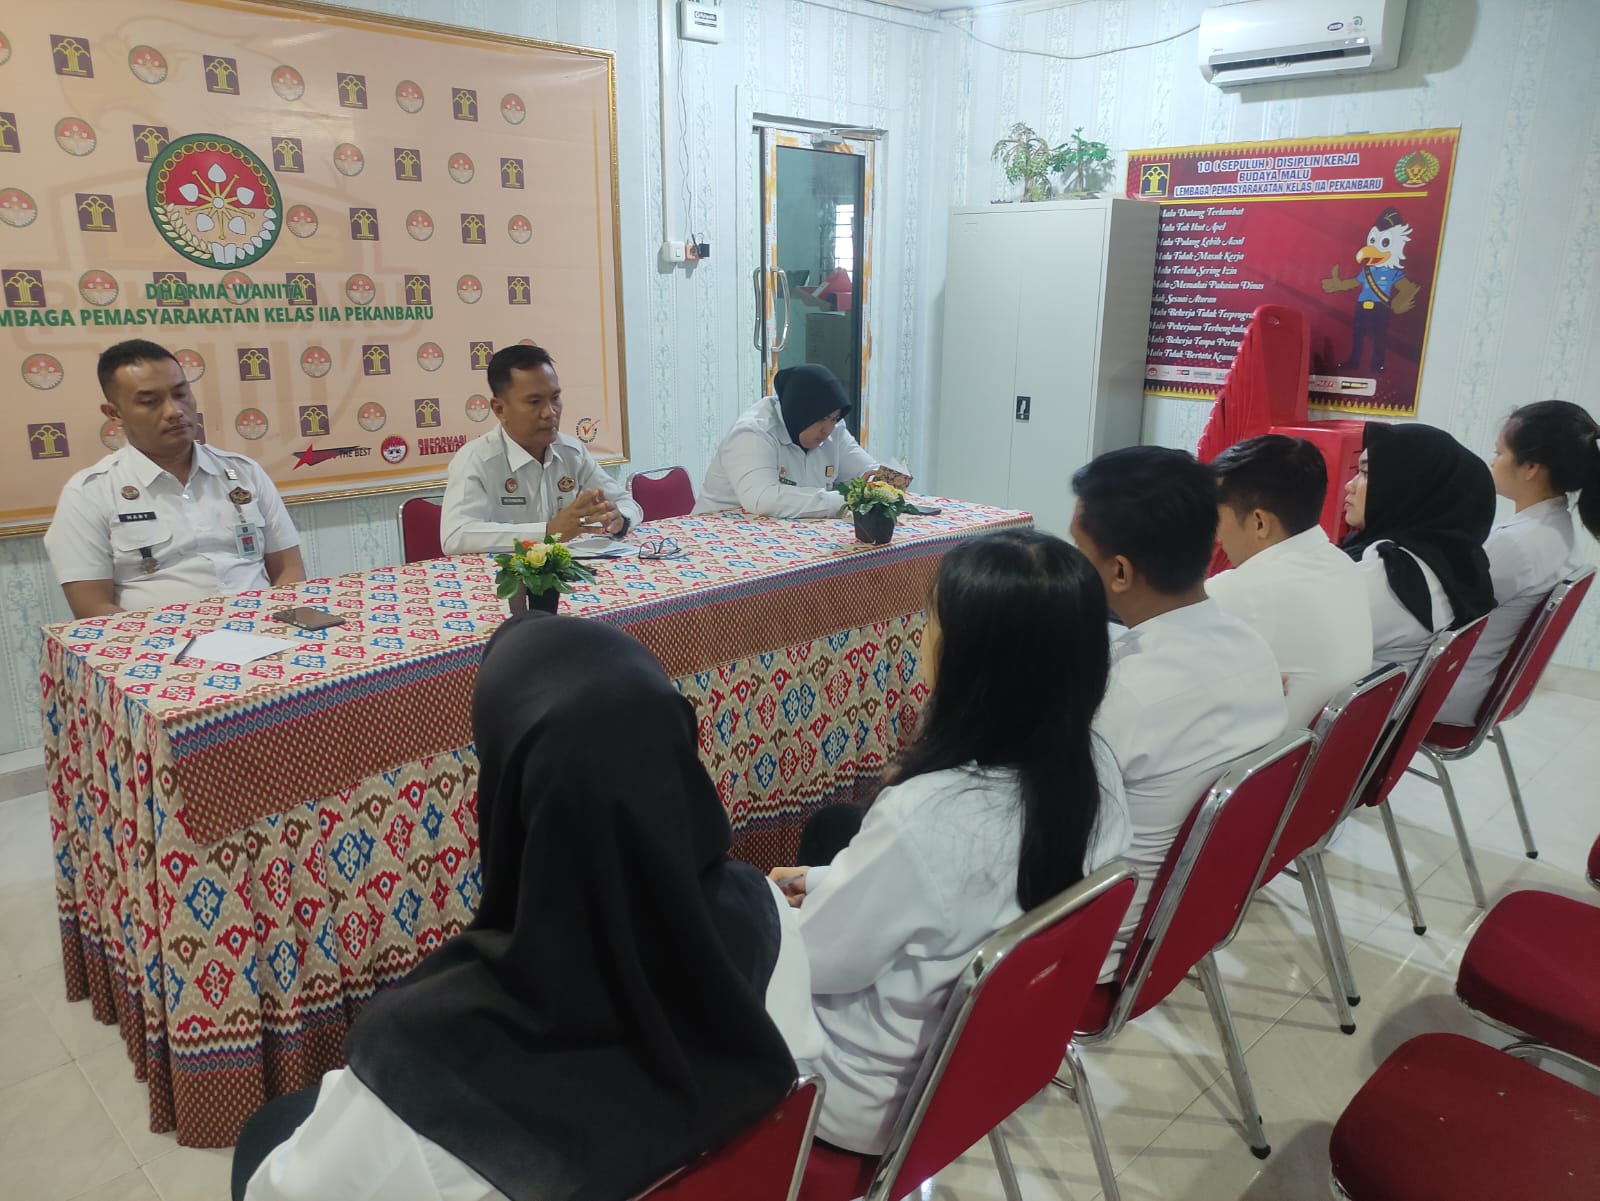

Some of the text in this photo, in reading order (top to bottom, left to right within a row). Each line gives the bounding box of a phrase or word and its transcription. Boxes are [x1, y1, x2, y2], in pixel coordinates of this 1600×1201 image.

[1199, 161, 1210, 172] 10
[1276, 156, 1320, 169] DISIPLIN
[1324, 154, 1360, 166] KERJA
[1239, 168, 1310, 182] BUDAYA MALU
[1174, 178, 1382, 197] LEMBAGA PEMASYARAKATAN KELAS IIA PEKANBARU
[1160, 208, 1244, 220] alu Datang Terlambat
[1176, 222, 1190, 232] Tak
[1205, 222, 1227, 233] Apel
[1174, 238, 1201, 248] Pulang
[1201, 237, 1220, 248] Lebih
[1221, 237, 1245, 246] Awal
[1173, 252, 1194, 260] Tidak
[1194, 252, 1223, 261] Masuk
[1224, 252, 1245, 262] Kerja
[1172, 266, 1197, 274] Terlalu
[1196, 266, 1222, 277] Sering
[1222, 266, 1238, 275] Izin
[1170, 280, 1208, 290] Memakai
[1208, 281, 1240, 289] Pakaian
[1240, 281, 1264, 290] Dinas
[144, 282, 304, 300] DHARMA WANITA
[1165, 294, 1189, 304] Sesuai
[1188, 294, 1216, 304] Aturan
[80, 308, 260, 326] PEMASYARAKATAN
[264, 306, 315, 323] KELAS
[319, 306, 341, 322] IIA
[344, 306, 434, 321] PEKANBARU
[1168, 308, 1196, 320] Bekerja
[1197, 308, 1218, 318] Tidak
[1167, 322, 1202, 332] Pekerjaan
[1166, 336, 1193, 346] Bekerja
[1194, 336, 1216, 348] Tanpa
[1164, 349, 1184, 358] Tidak
[1184, 350, 1212, 360] Bertata
[418, 434, 467, 446] REFORMASI
[354, 448, 371, 456] BEST
